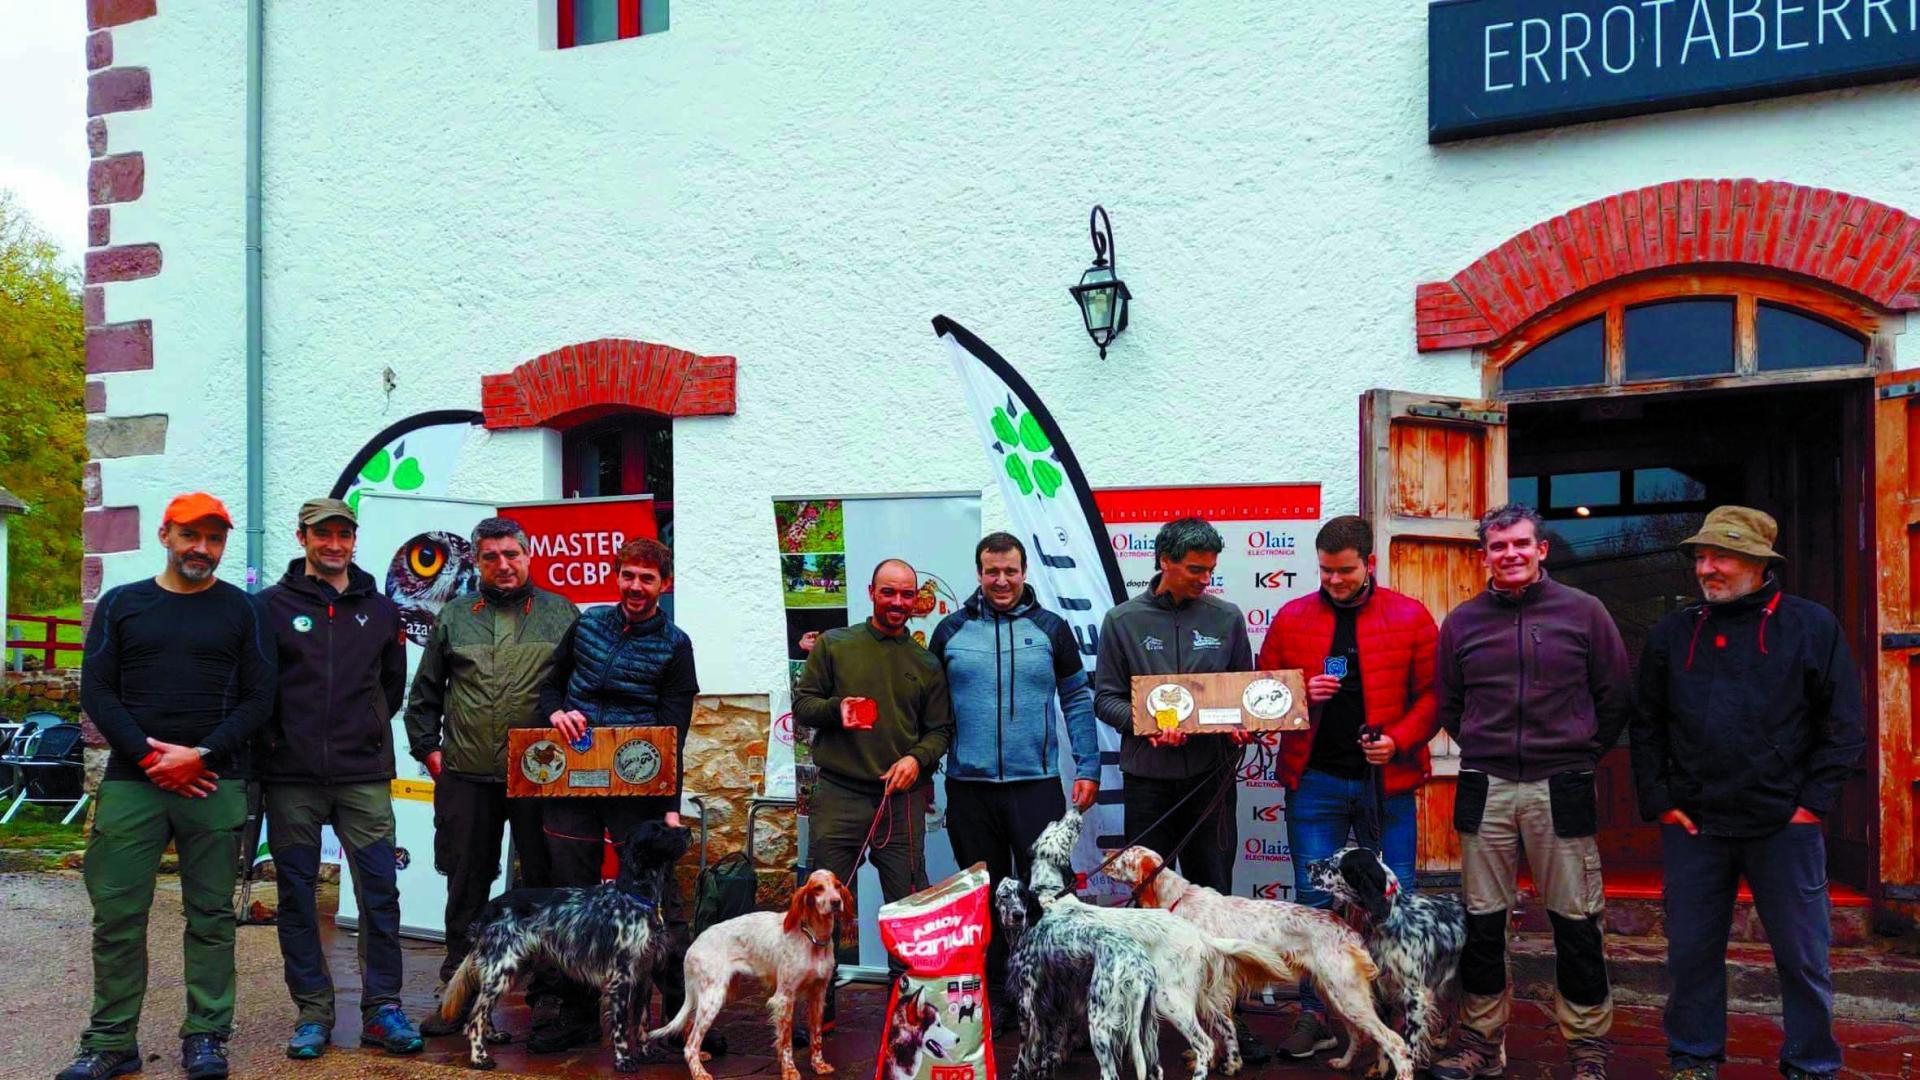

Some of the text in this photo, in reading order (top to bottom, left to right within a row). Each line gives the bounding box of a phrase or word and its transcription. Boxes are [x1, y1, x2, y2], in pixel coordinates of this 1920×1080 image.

[530, 531, 625, 557] MASTER
[1112, 533, 1155, 550] Olaiz
[1248, 531, 1295, 548] Olaiz
[548, 561, 611, 586] CCBP
[1255, 570, 1297, 588] KST
[401, 617, 432, 635] aza
[1246, 764, 1277, 780] Ola
[1245, 838, 1290, 854] Olaiz
[1253, 883, 1292, 900] KST
